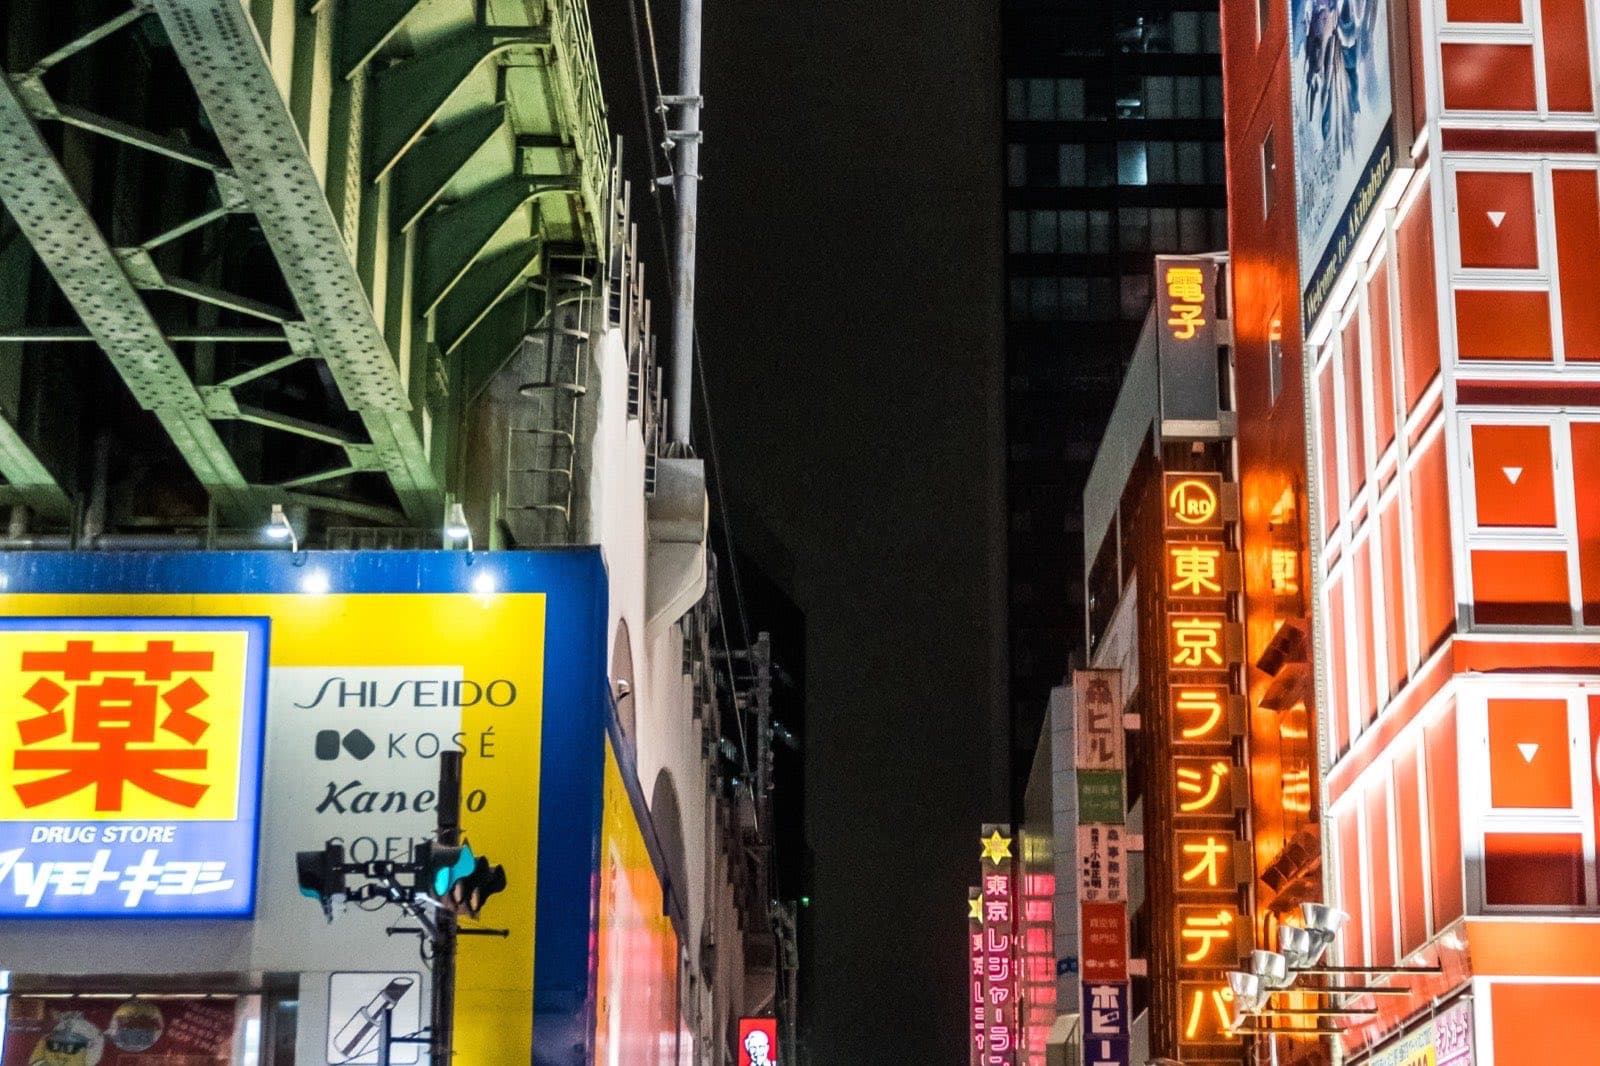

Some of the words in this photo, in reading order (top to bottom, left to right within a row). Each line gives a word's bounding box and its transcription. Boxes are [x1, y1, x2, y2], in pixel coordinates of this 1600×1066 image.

[1350, 145, 1391, 238] Akihabara
[1167, 267, 1206, 341] 電子
[294, 677, 518, 709] SHISEIDO
[13, 640, 215, 812] 薬
[388, 726, 496, 759] KOSÉ
[315, 780, 487, 814] Kaneo
[31, 826, 97, 843] DRUG
[102, 826, 177, 843] STORE
